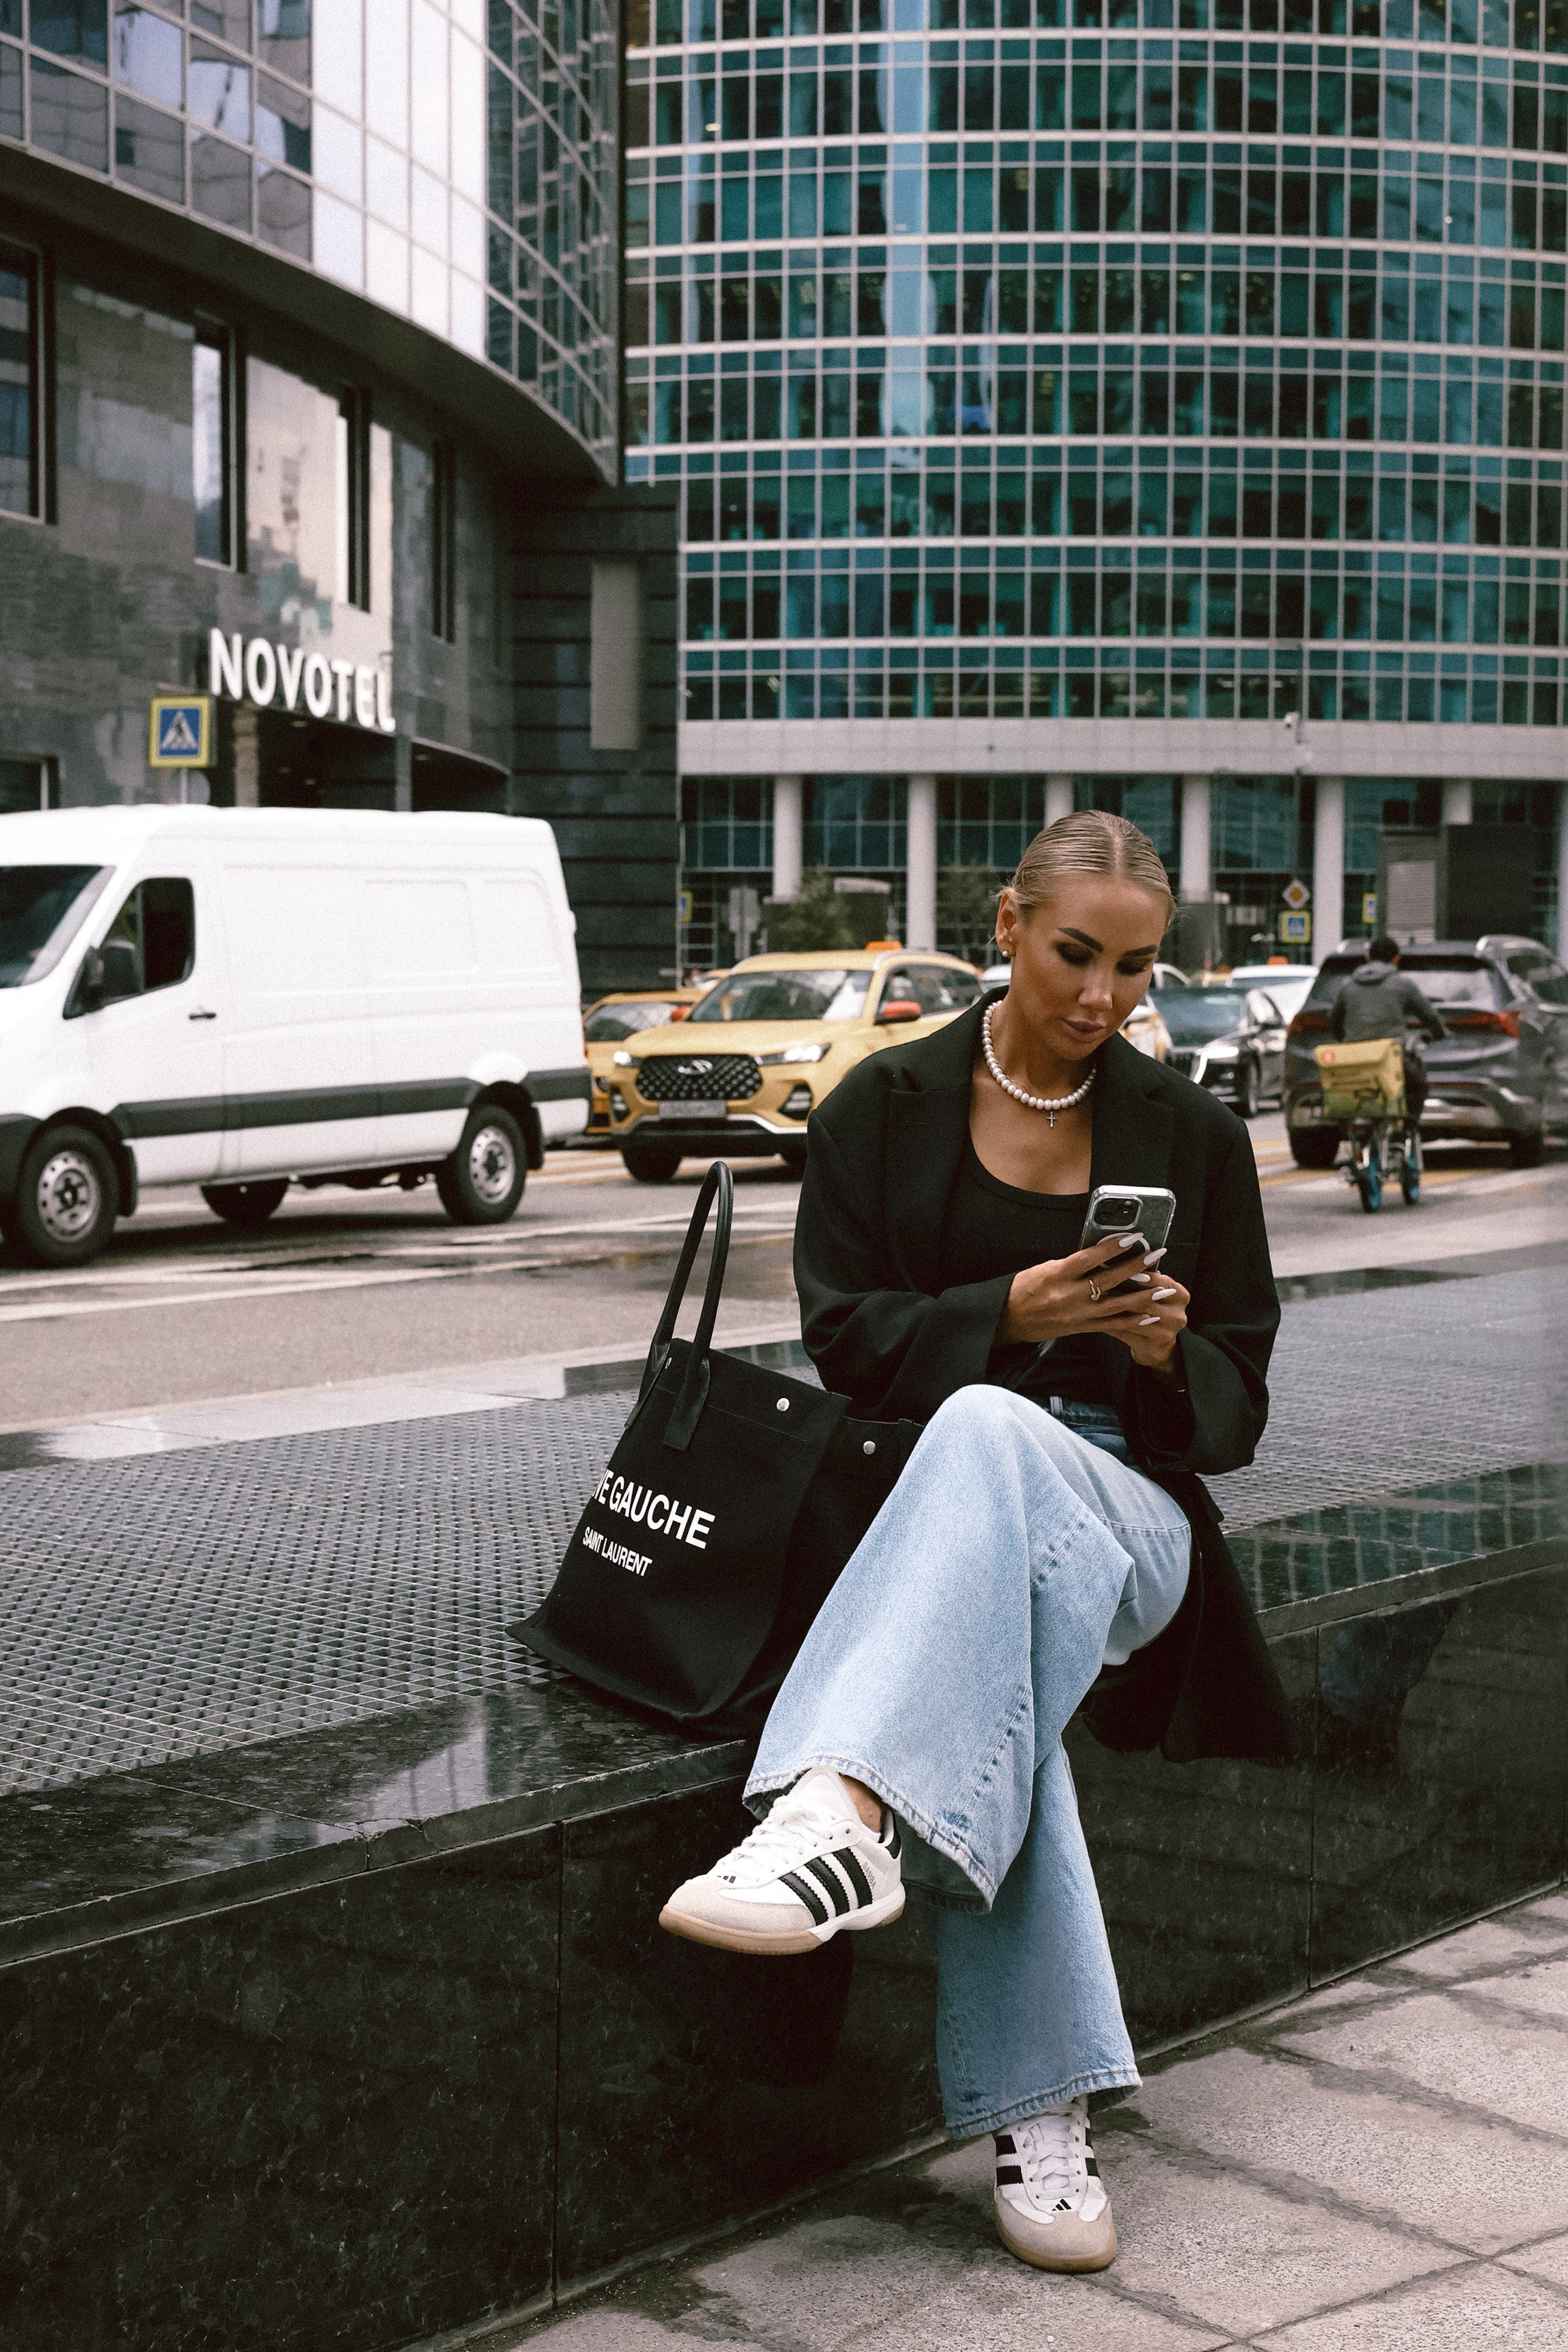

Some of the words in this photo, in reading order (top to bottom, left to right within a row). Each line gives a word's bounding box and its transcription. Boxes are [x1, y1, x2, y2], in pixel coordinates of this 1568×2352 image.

[210, 628, 396, 733] NOVOTEL
[609, 1476, 716, 1549] GAUCHE
[582, 1526, 604, 1553] SAINT
[601, 1538, 653, 1577] LAURENT
[863, 1861, 876, 1890] SAMBA
